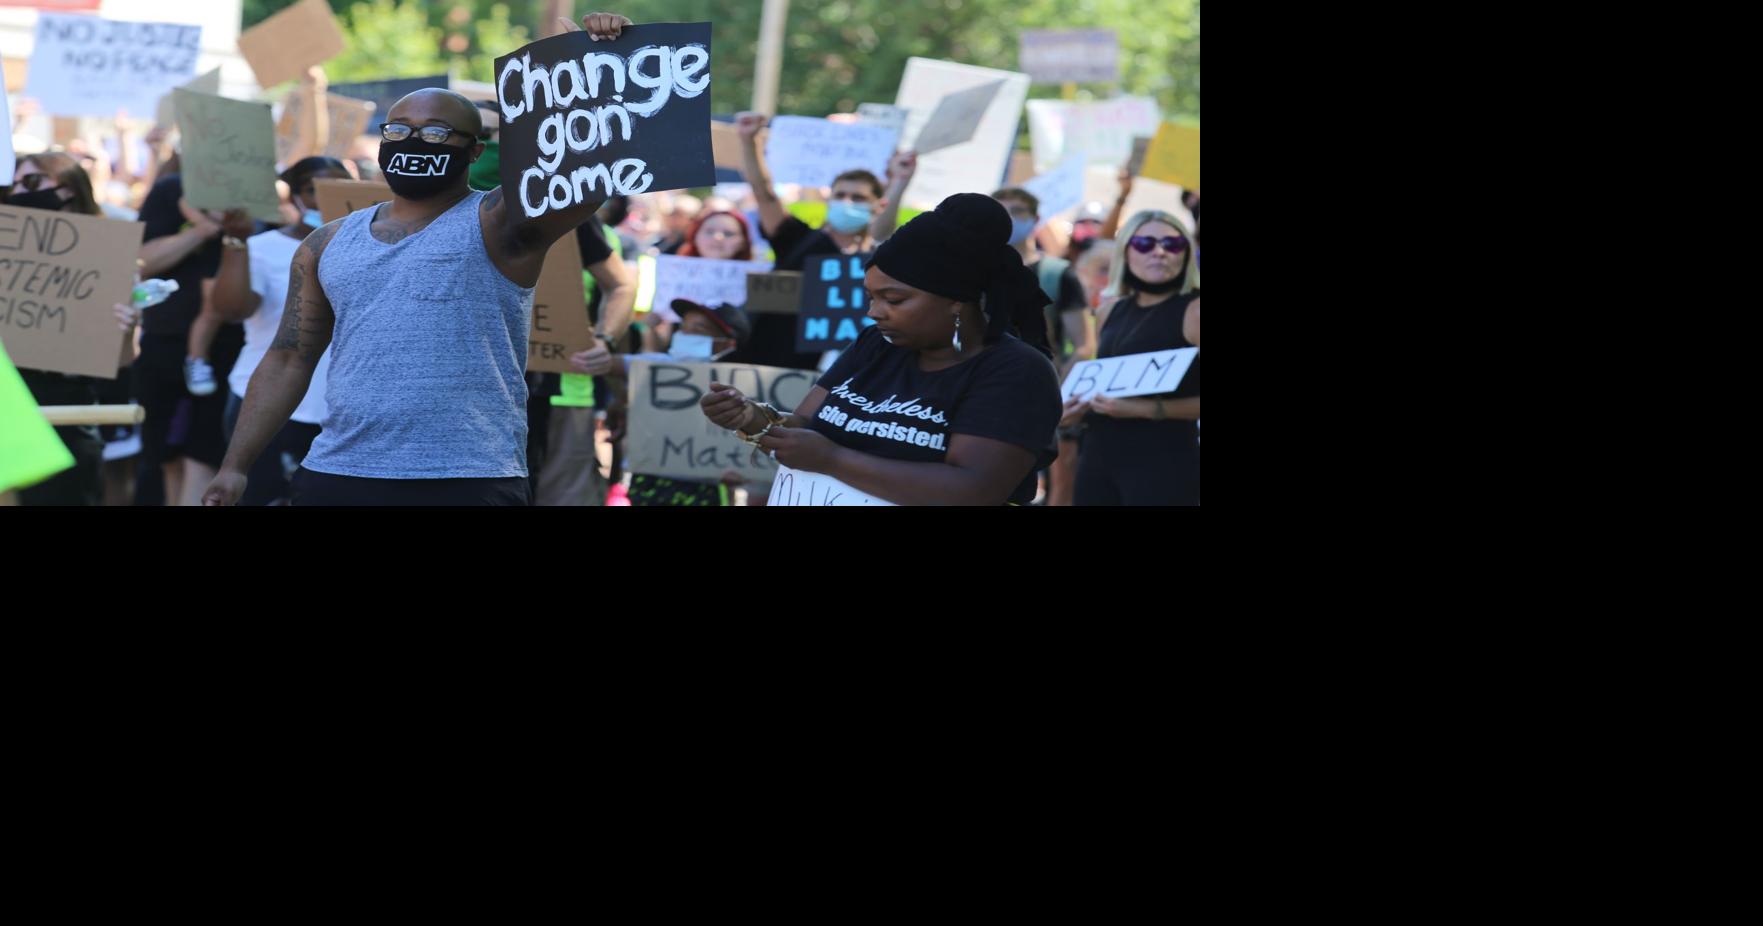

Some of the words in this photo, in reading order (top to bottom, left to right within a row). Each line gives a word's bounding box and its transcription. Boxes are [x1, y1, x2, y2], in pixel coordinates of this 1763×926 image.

[498, 43, 711, 124] Change
[386, 152, 451, 177] ABN
[519, 157, 654, 218] Come
[1069, 353, 1178, 398] BLM
[817, 404, 846, 428] she
[845, 417, 947, 451] persisted.
